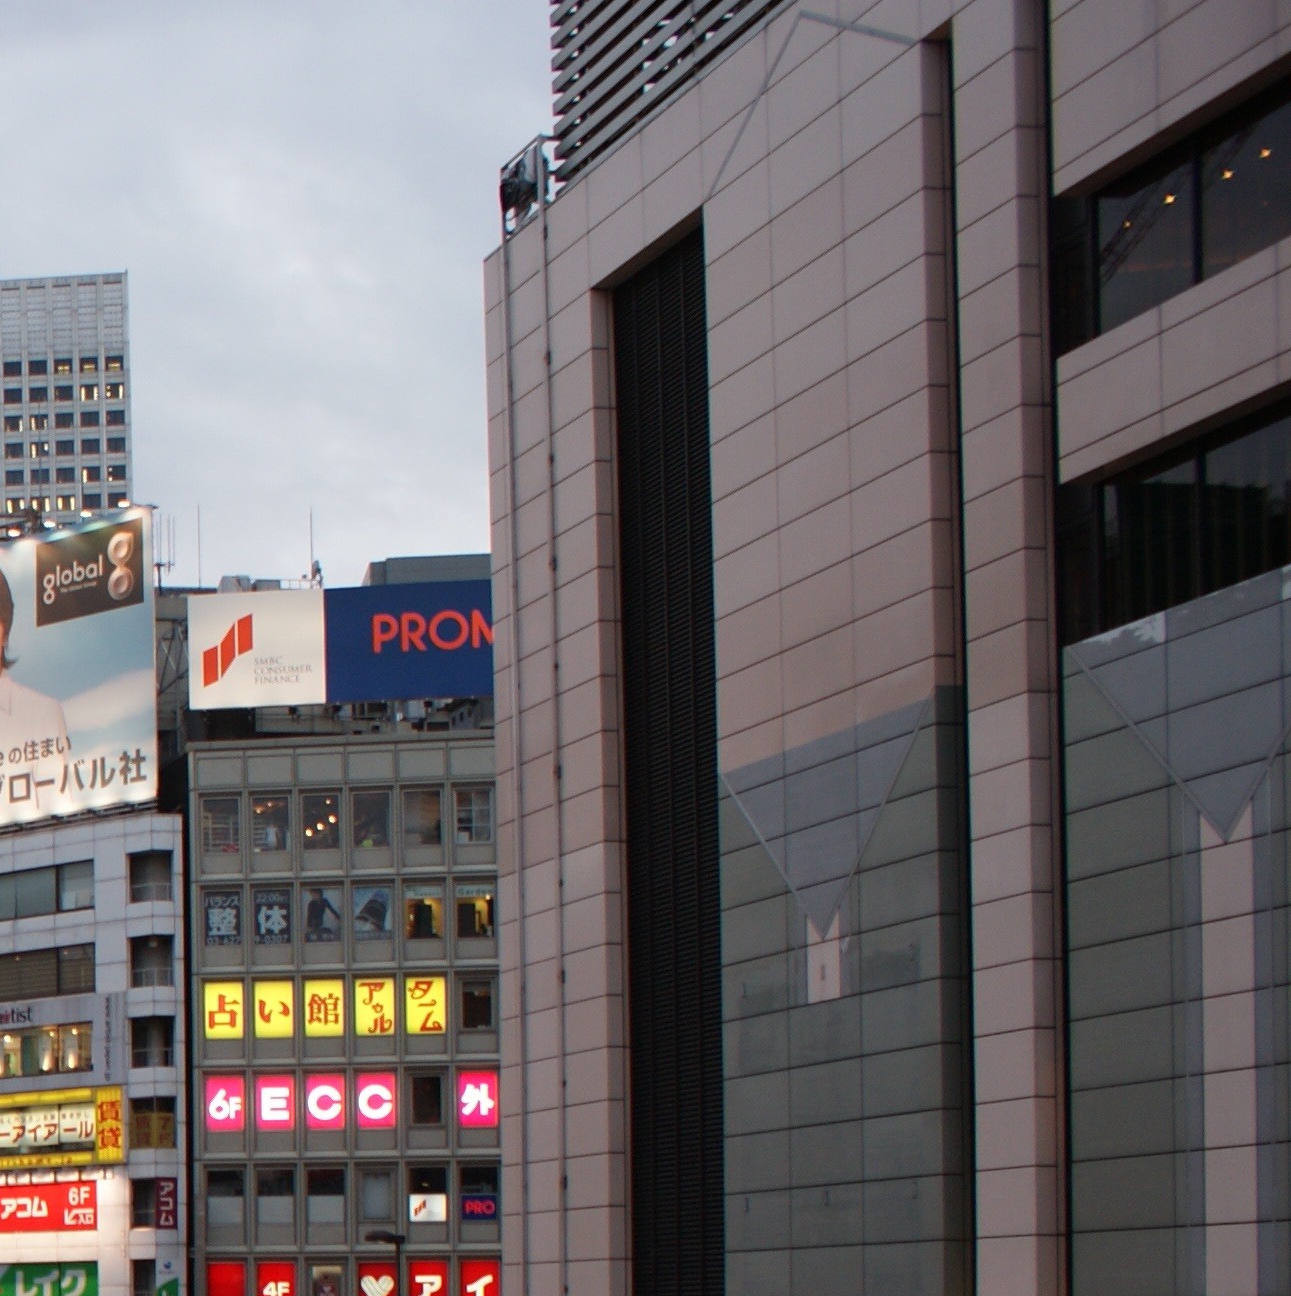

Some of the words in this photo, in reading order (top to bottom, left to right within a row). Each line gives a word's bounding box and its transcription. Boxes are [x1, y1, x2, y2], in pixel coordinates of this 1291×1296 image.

[43, 554, 104, 605] global
[254, 656, 282, 666] SMBC
[254, 664, 313, 676] CONSUMER
[254, 674, 300, 685] FINANCE
[7, 735, 72, 765] の住まい
[207, 990, 341, 1030] 占い館
[207, 1088, 243, 1121] 6F
[260, 1084, 394, 1121] ECC
[460, 1083, 496, 1116] 外
[0, 1195, 49, 1220] アコム
[67, 1186, 92, 1207] 6F
[160, 1181, 174, 1226] アコム
